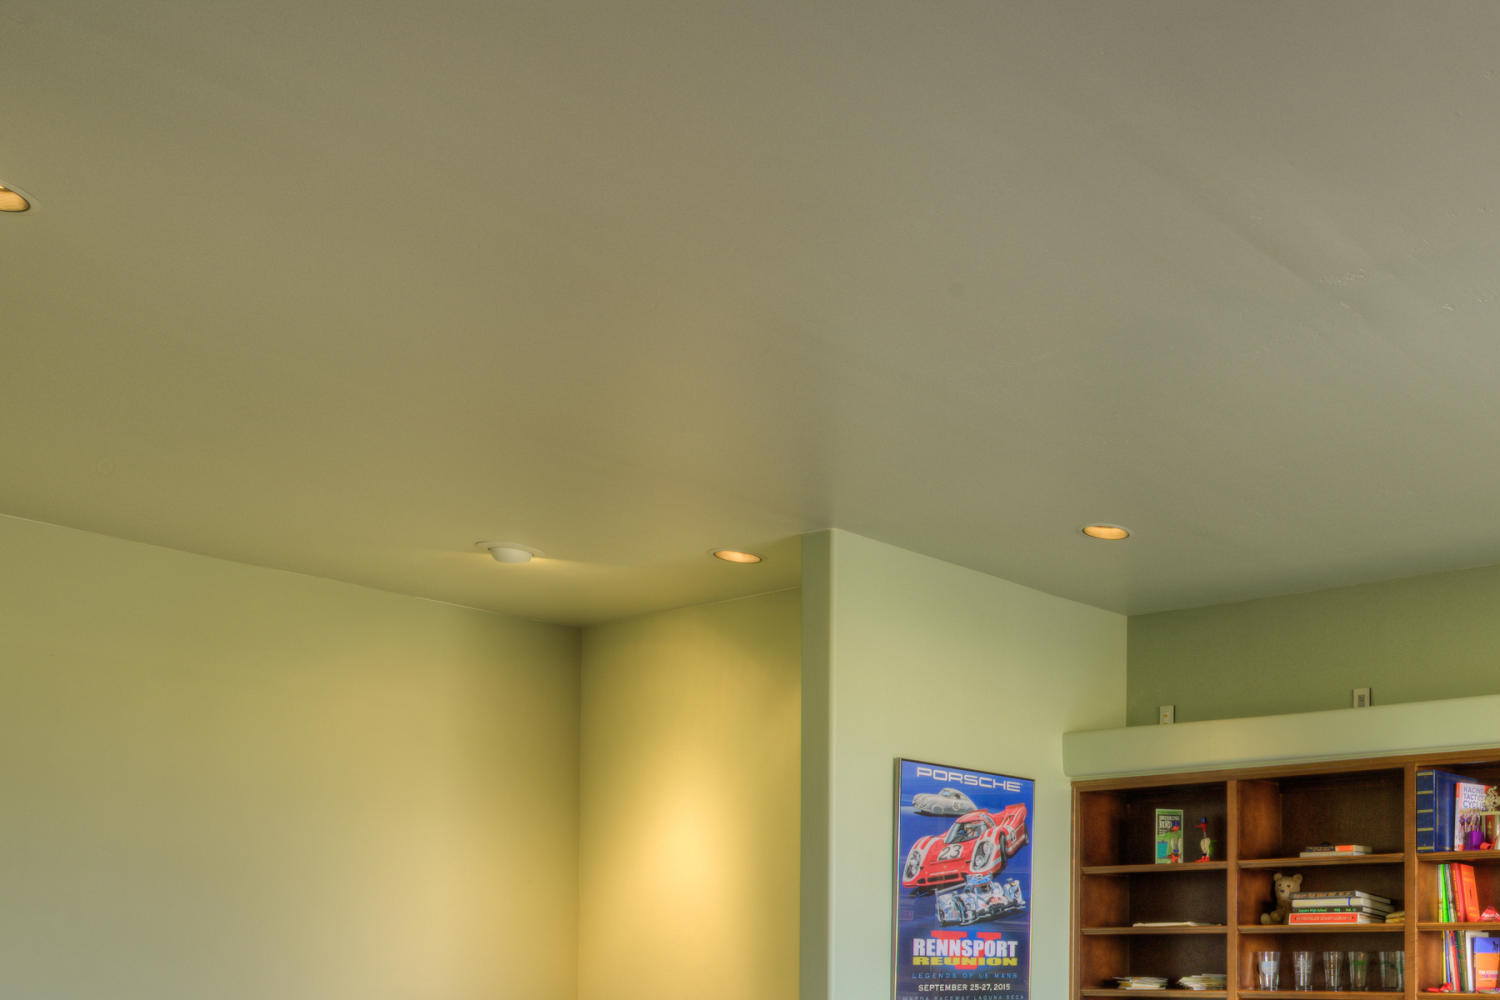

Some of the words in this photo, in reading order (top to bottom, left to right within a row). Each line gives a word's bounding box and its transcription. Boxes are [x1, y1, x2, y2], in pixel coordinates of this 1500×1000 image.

[916, 767, 1021, 793] PORSCHE
[939, 845, 962, 861] 23
[912, 938, 1018, 957] RENNSPORT
[912, 956, 1018, 966] REUNION
[918, 984, 967, 992] SEPTEMBER
[970, 983, 992, 992] 25-27,
[994, 983, 1011, 991] 2015
